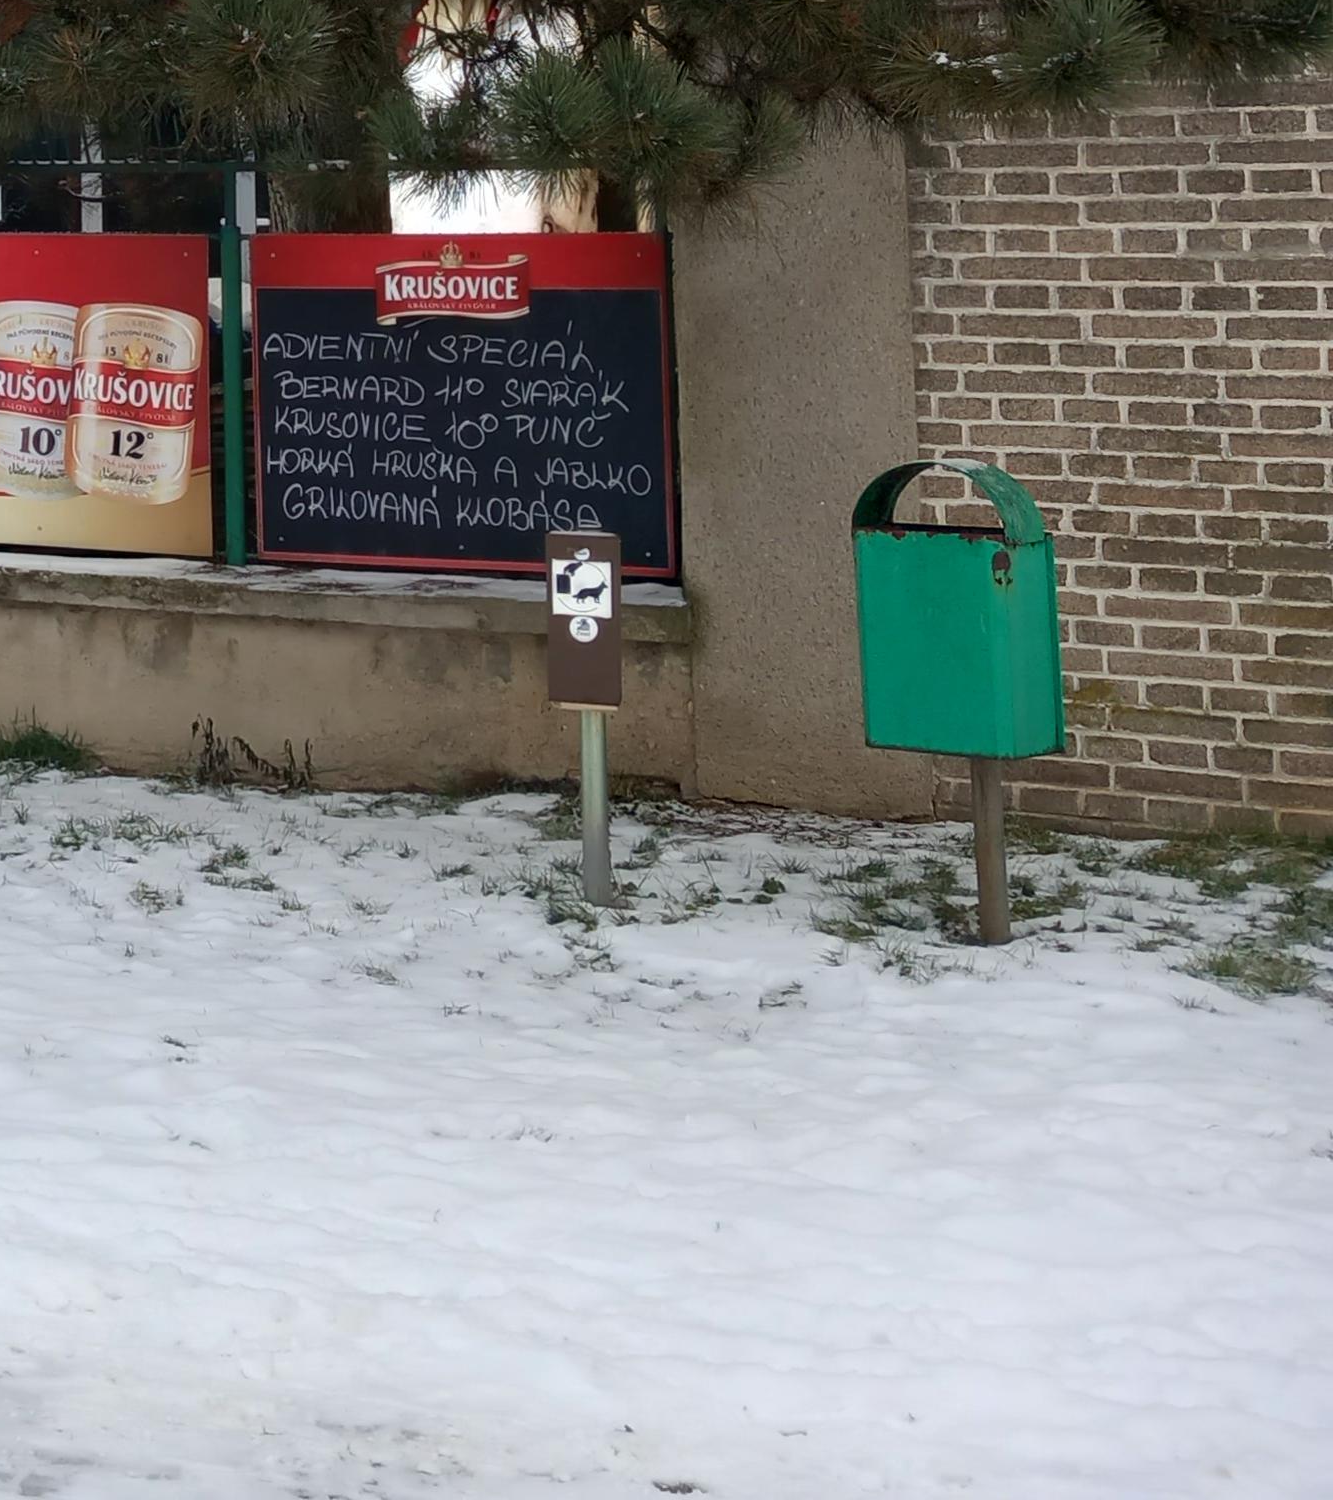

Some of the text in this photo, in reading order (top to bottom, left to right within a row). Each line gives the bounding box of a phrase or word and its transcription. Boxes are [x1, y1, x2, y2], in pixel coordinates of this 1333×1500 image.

[384, 270, 519, 301] KRUŠOVICE
[263, 320, 594, 373] ADVENTNÍ SPECIÁL
[73, 367, 195, 412] KRUŠOVICE
[273, 370, 425, 407] BERNARD
[501, 370, 629, 412] SVAŘÁK
[505, 410, 612, 448] PUNČ
[267, 443, 652, 496] HORKÁ HRUŠKA A JABLKO
[283, 483, 602, 532] GRILOVANÁ KLOBÁSA
